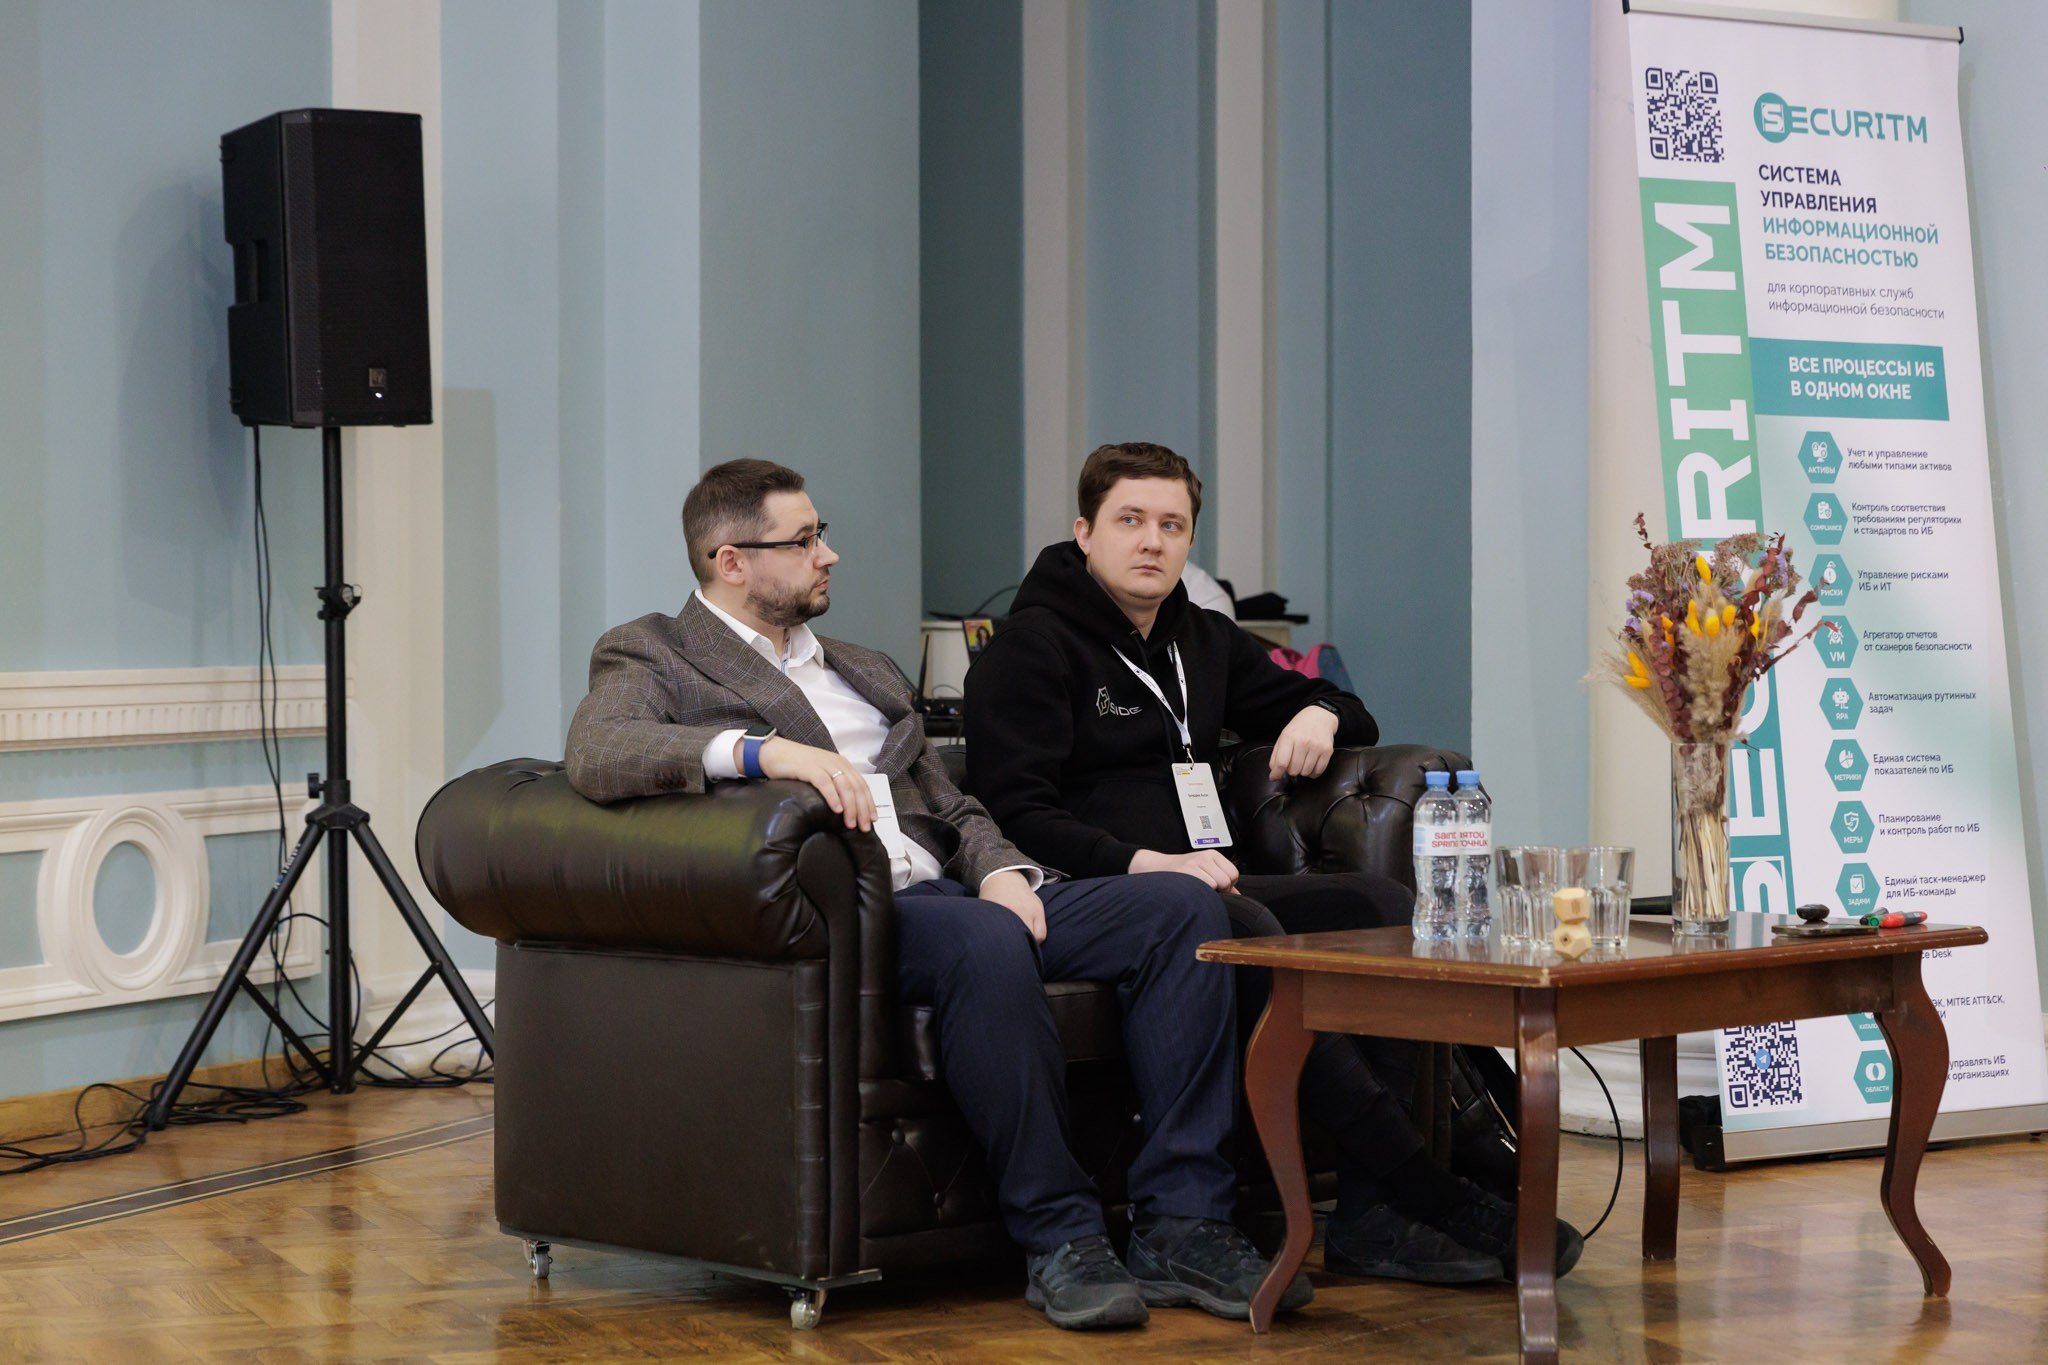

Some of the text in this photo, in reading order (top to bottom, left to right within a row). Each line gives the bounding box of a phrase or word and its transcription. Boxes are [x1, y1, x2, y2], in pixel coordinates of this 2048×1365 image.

[1754, 92, 1928, 144] SECURITM
[1758, 164, 1842, 187] СИСТЕМА
[1760, 190, 1877, 214] УПРАВЛЕНИЯ
[1763, 216, 1939, 245] ИНФОРМАЦИОННОЙ
[1765, 243, 1919, 269] БЕЗОПАСНОСТЬЮ
[1767, 282, 1914, 301] для корпоративных служб
[1768, 299, 1945, 319] информационной безопасности
[1788, 356, 1935, 379] ВСЕ ПРОЦЕССЫ ИБ
[1791, 380, 1911, 400] В ОДНОМ ОКНЕ
[1847, 448, 1866, 457] Учет
[1875, 450, 1928, 460] управление
[1808, 466, 1836, 475] АКТИВЫ
[1848, 461, 1952, 471] любыми типами активов
[1851, 503, 1889, 513] Контроль
[1853, 514, 1906, 524] требованиям
[1860, 527, 1907, 536] стандартов
[1921, 527, 1934, 535] ИБ
[1858, 570, 1949, 582] Управление рисками
[1858, 582, 1871, 592] ИБ
[1880, 582, 1892, 592] ИТ
[1863, 630, 1938, 641] Агрегатор отчетов
[1864, 641, 1973, 654] от сканеров безопасности
[1829, 651, 1846, 663] VM
[1868, 691, 1976, 703] Автоматизация рутинных
[1869, 704, 1894, 714] задач
[1873, 754, 1941, 764] Единая система
[1874, 764, 1954, 776] показателей по ИБ
[1879, 814, 1941, 825] Планирование
[1880, 823, 1980, 837] и контроль работ по ИБ
[1843, 836, 1864, 844] МЕРЫ
[1885, 874, 1985, 886] Единый таск-менеджер
[1886, 886, 1956, 898] для ИБ-команды
[1847, 897, 1871, 906] ЗАДАЧИ
[1932, 949, 1953, 959] Desk
[1946, 998, 1971, 1008] MITRE
[1858, 1022, 1879, 1030] КАТАЛО
[1950, 1055, 2007, 1070] управлять ИБ
[1952, 1068, 2010, 1081] организациях
